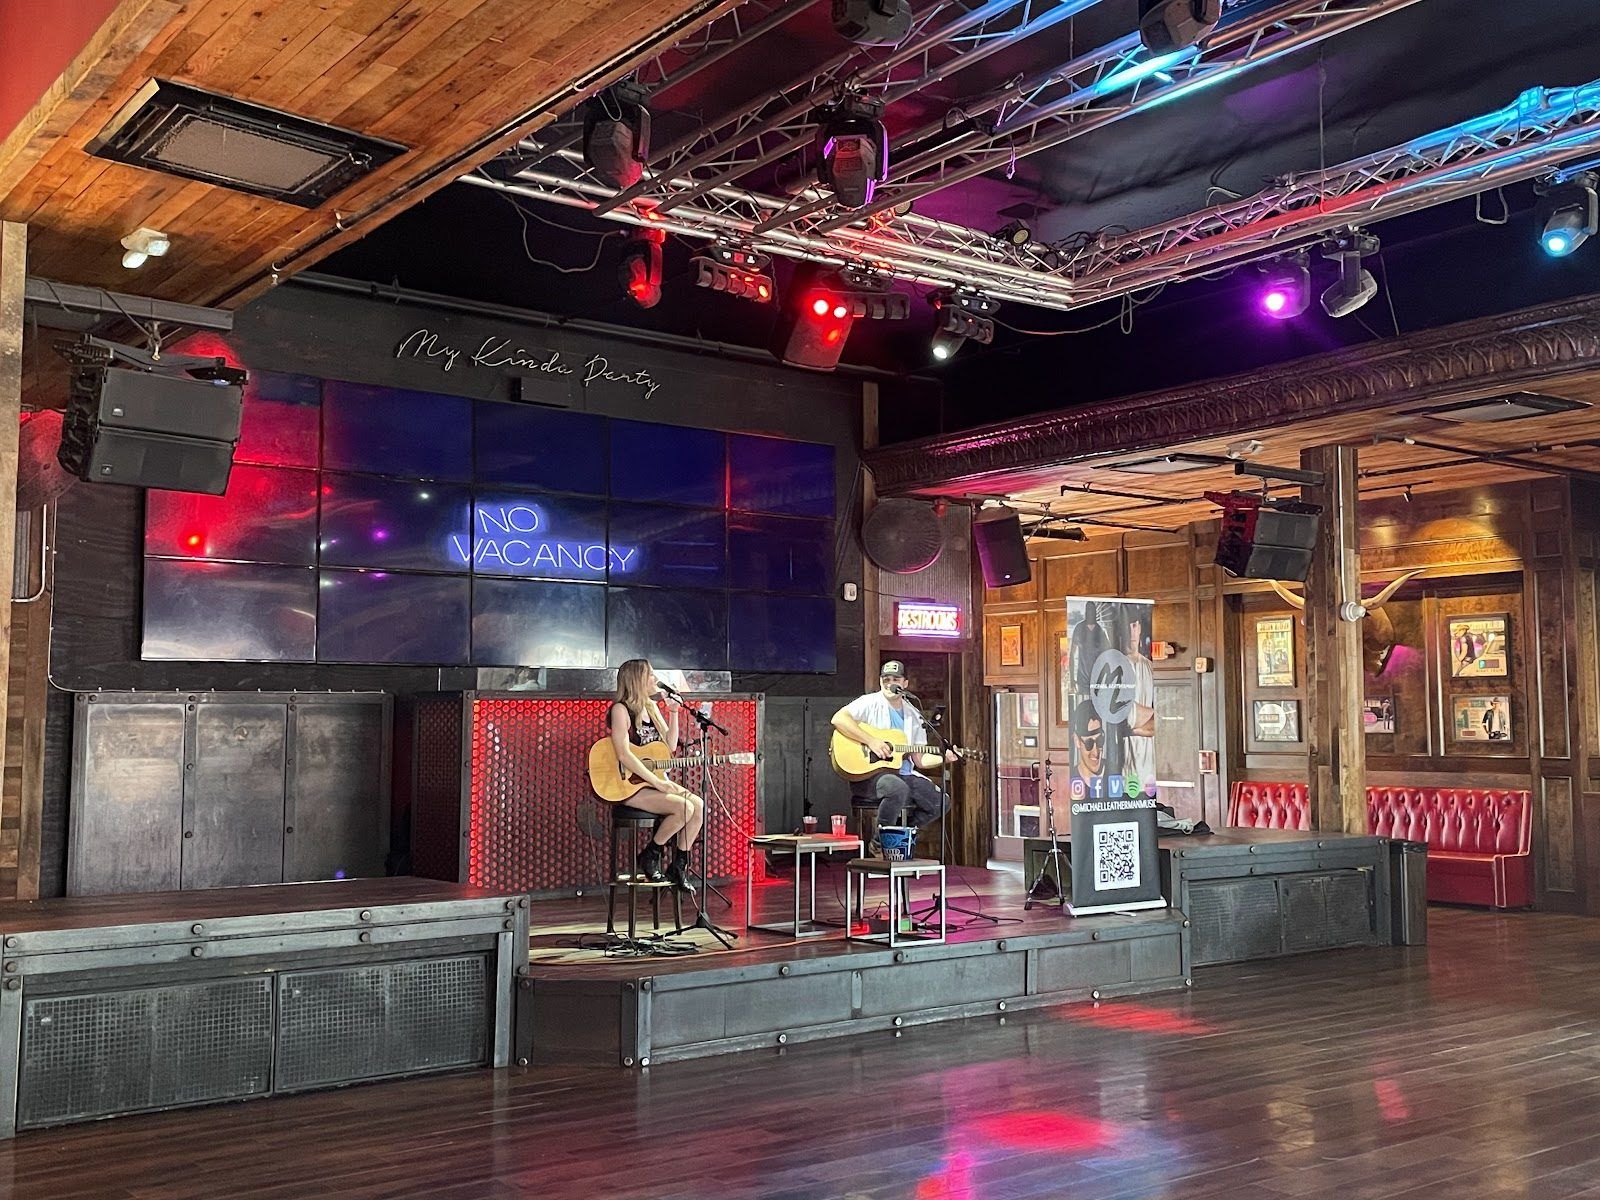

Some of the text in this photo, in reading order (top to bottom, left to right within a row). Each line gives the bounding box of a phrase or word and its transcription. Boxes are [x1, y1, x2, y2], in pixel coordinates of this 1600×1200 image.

[396, 329, 661, 400] My Kinda Party
[478, 506, 540, 534] NO
[453, 535, 635, 572] VACANCY
[897, 609, 958, 631] RESTROOMS
